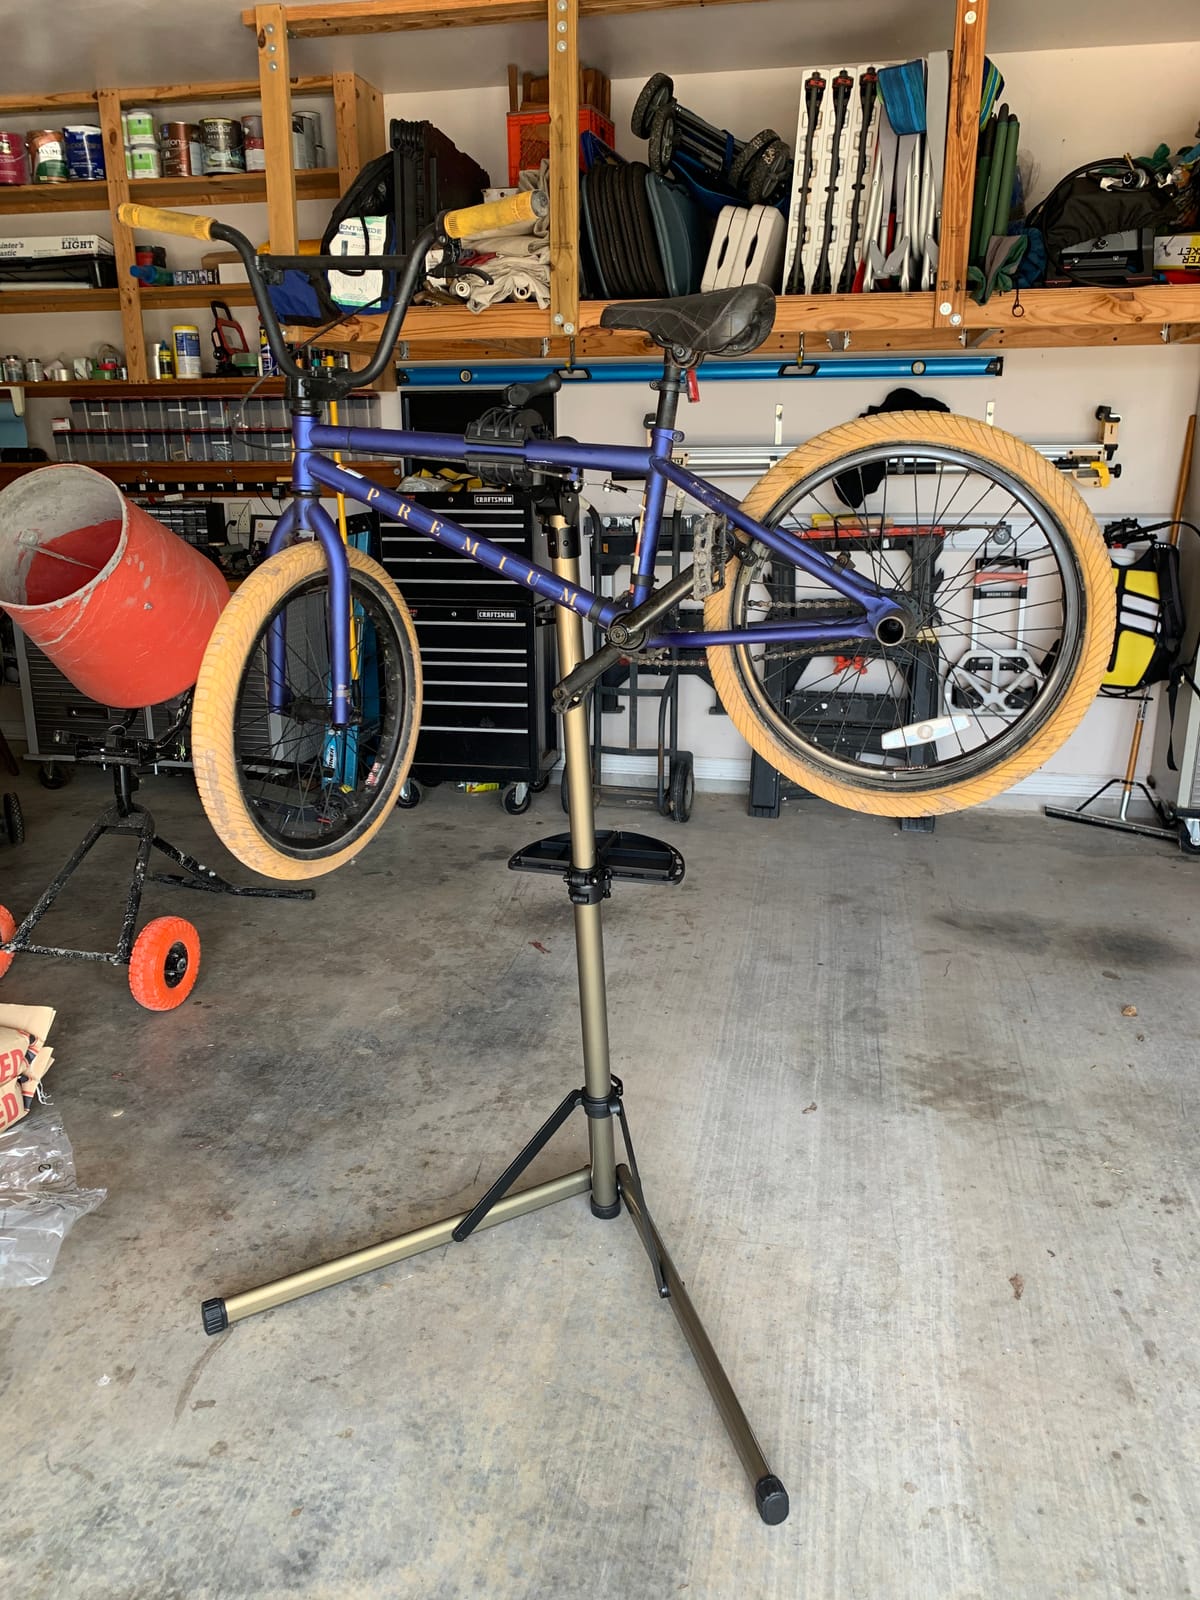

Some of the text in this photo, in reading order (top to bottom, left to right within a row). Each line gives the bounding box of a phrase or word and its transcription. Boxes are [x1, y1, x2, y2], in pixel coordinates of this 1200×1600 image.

[205, 123, 232, 134] valspar
[61, 240, 95, 250] LIGHT
[366, 487, 579, 607] PREMIUM
[478, 611, 515, 619] CRAFTSMAN
